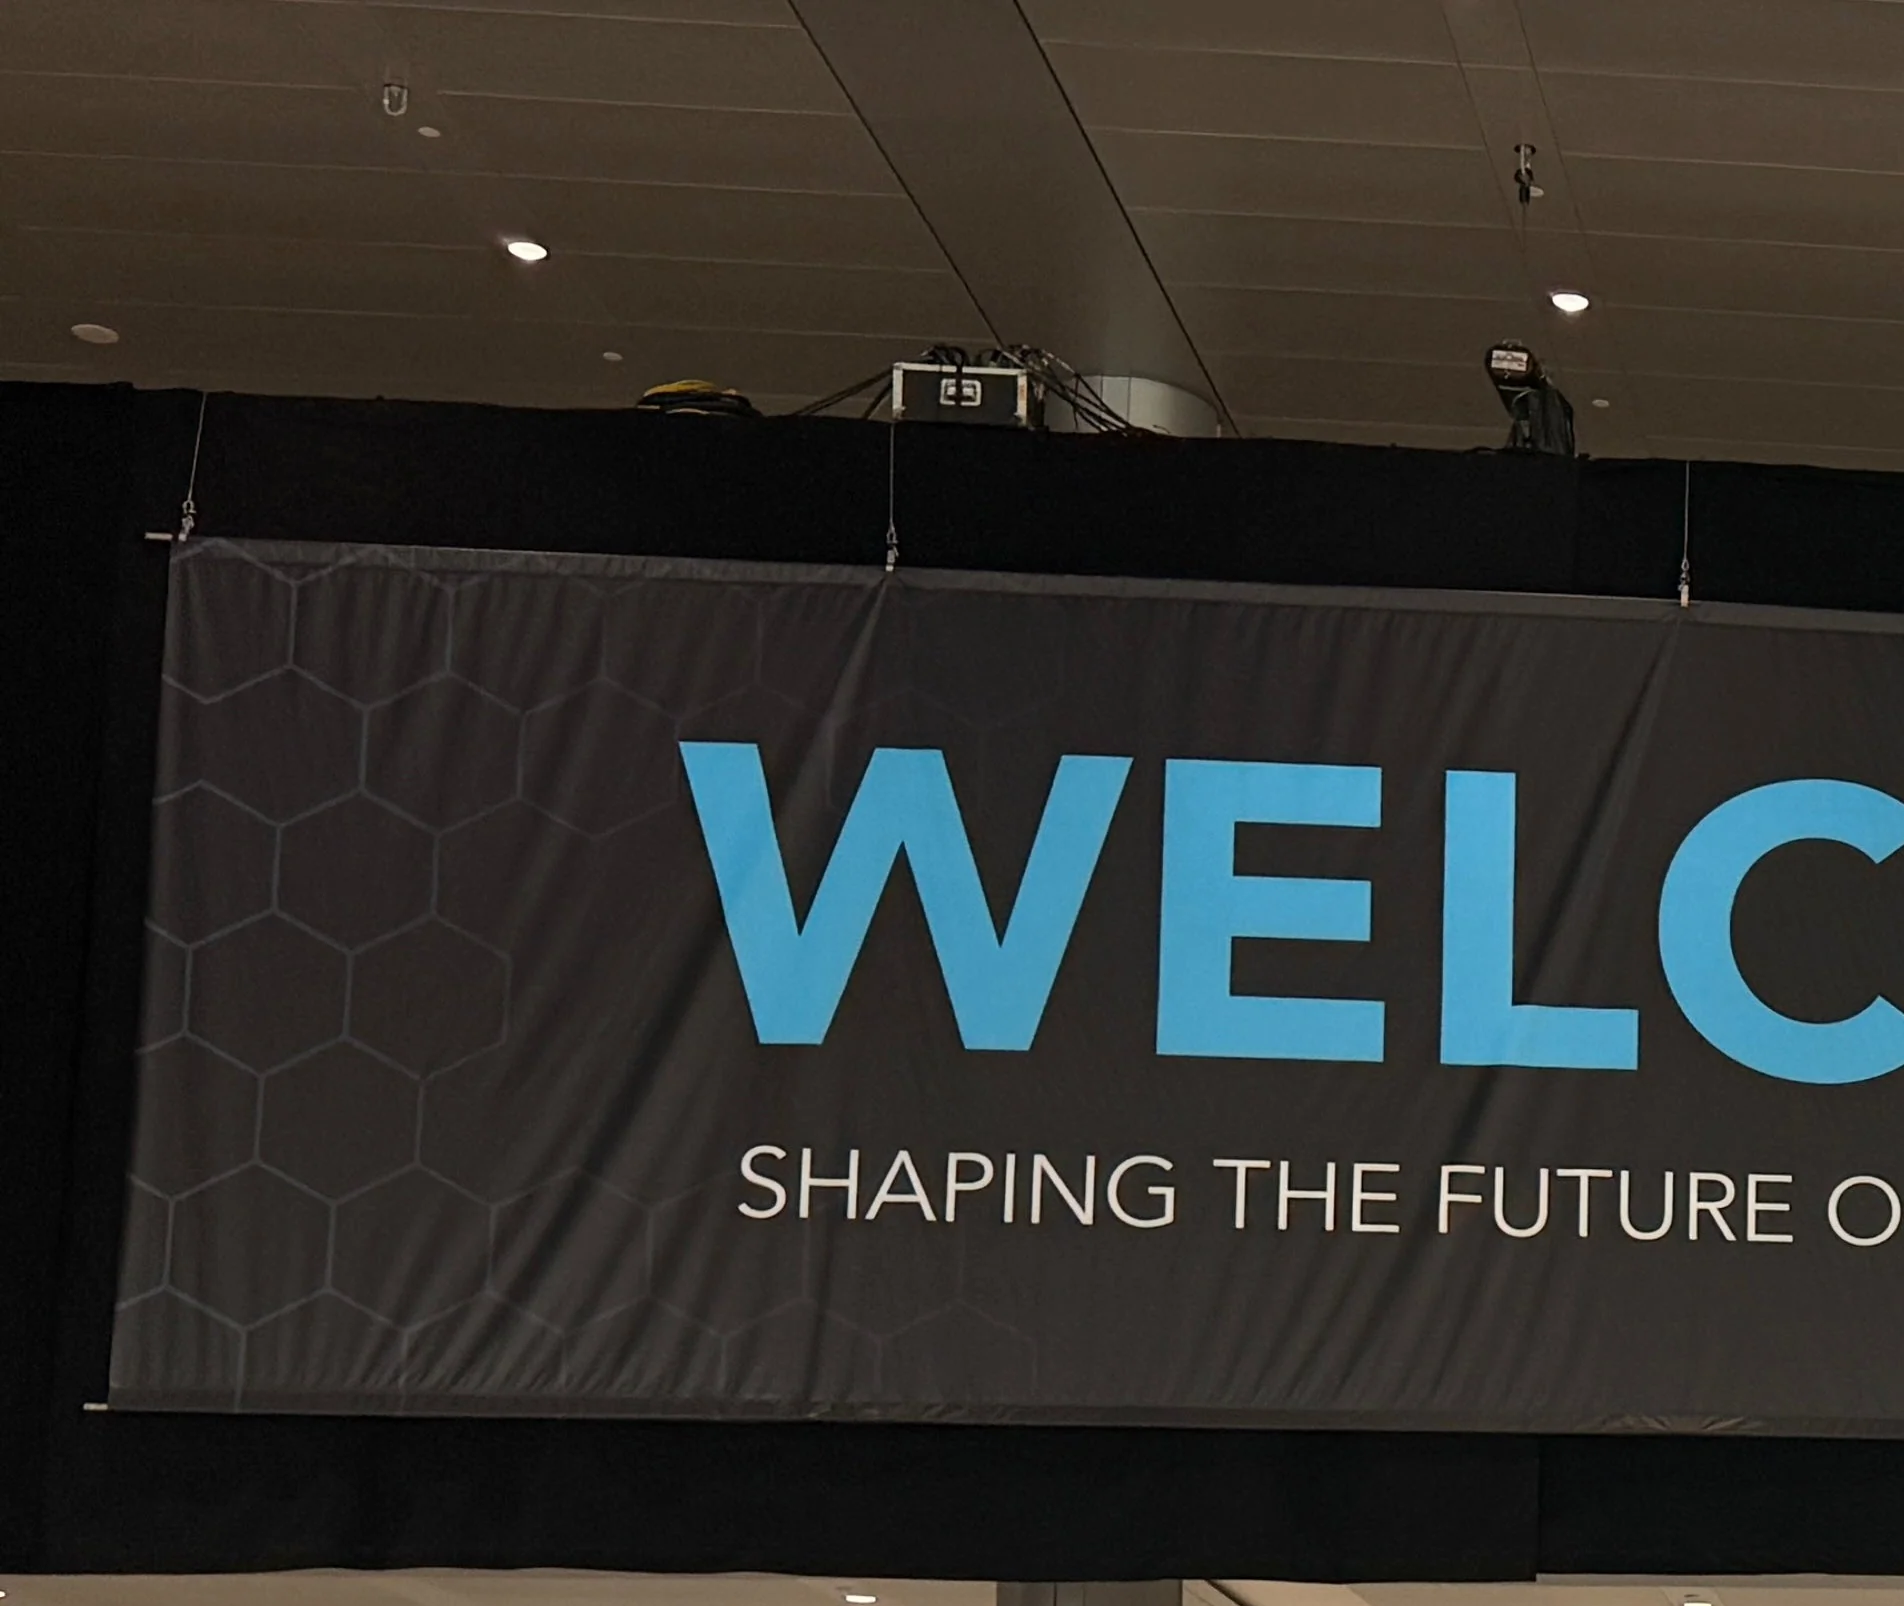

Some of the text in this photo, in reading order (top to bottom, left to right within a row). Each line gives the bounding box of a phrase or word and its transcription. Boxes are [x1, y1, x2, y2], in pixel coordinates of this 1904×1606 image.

[738, 1144, 1175, 1226] SHAPING
[1212, 1158, 1400, 1232] THE
[1438, 1163, 1794, 1243] FUTURE
